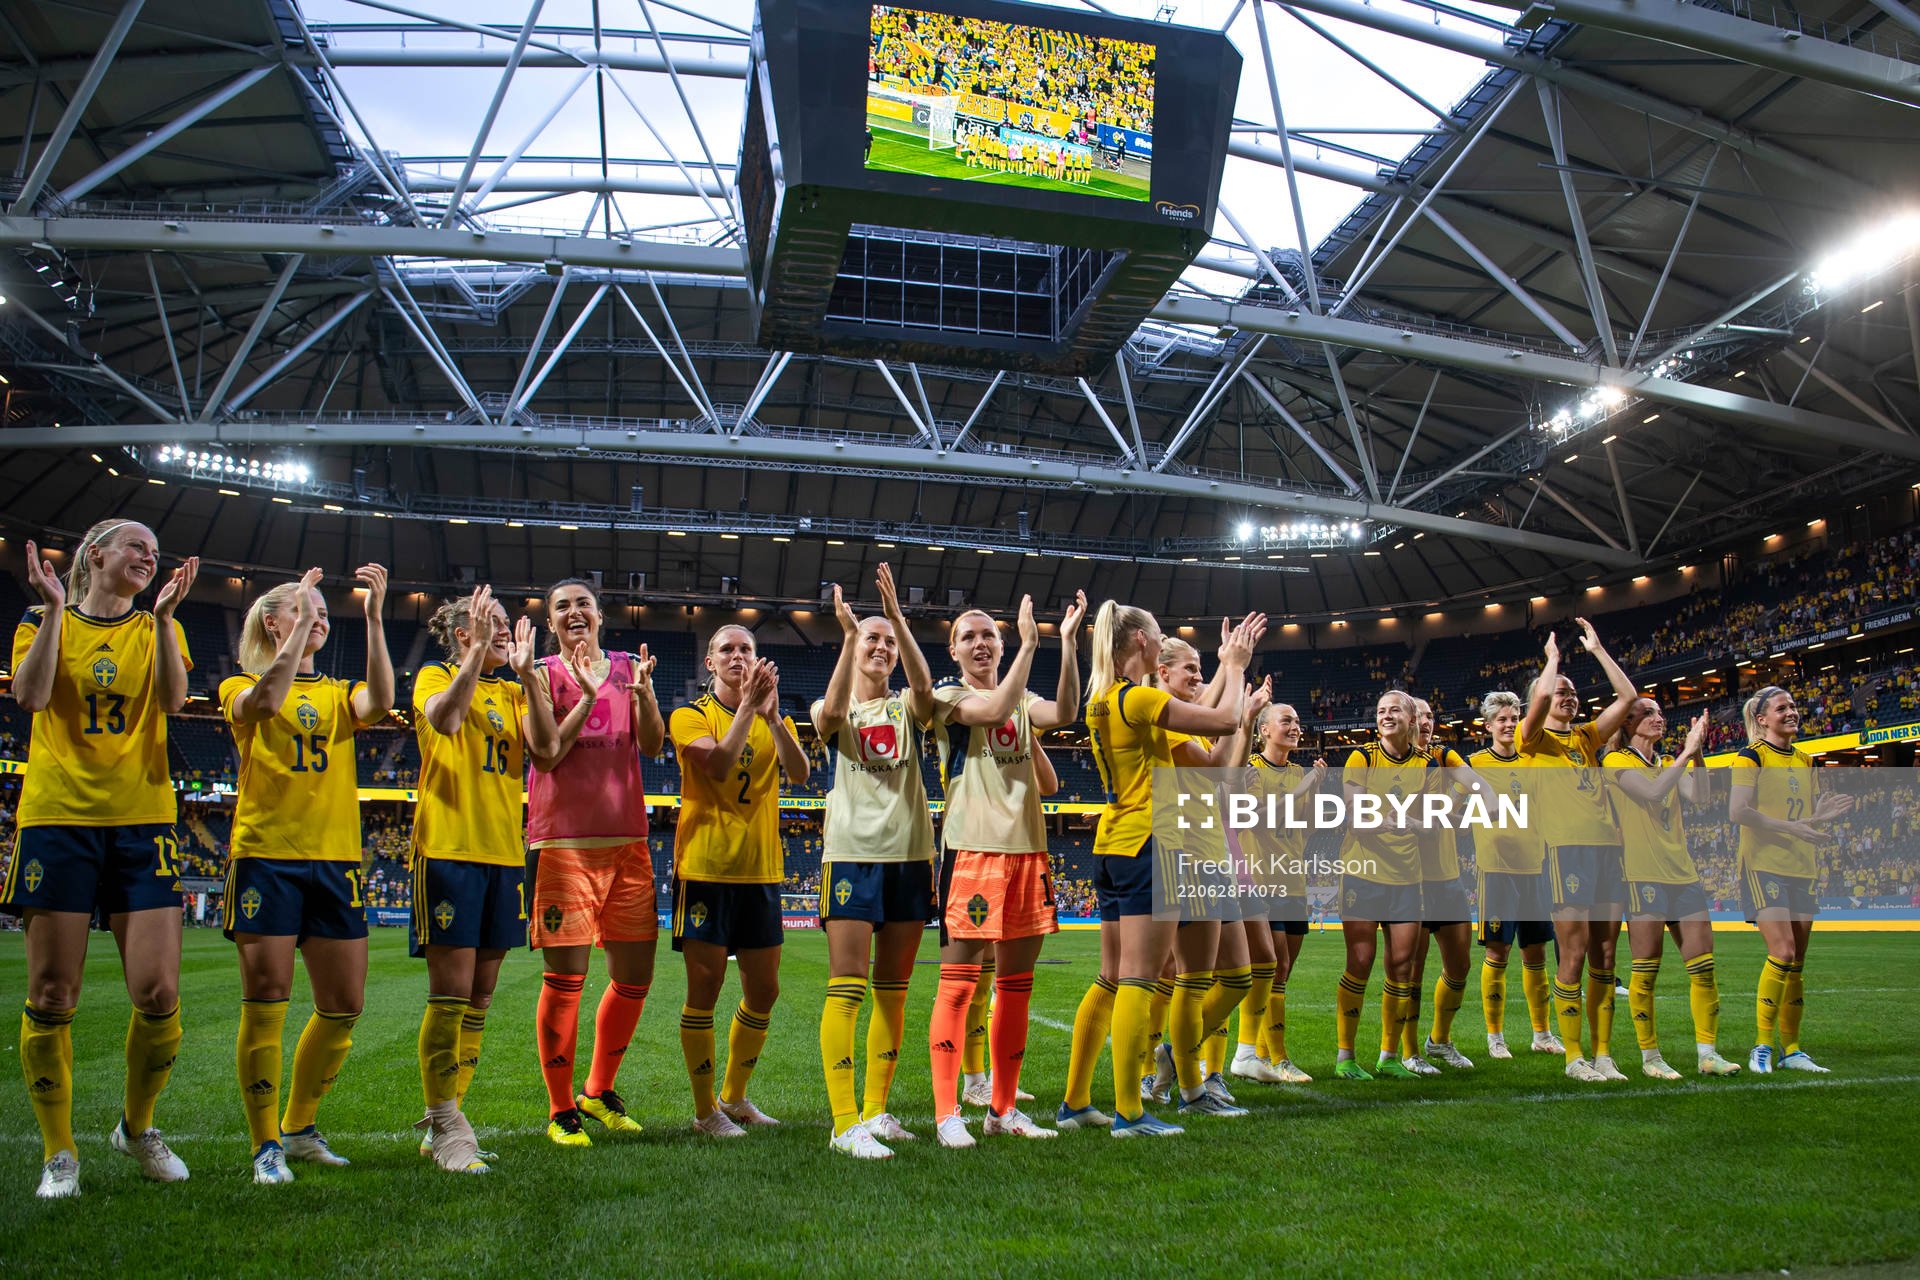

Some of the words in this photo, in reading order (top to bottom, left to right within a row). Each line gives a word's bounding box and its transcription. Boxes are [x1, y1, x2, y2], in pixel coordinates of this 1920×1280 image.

[1162, 205, 1193, 218] friends
[1865, 618, 1889, 630] FRIENDS
[1891, 611, 1911, 624] ARENA
[1772, 638, 1807, 652] TILLSAMMANS
[1808, 635, 1820, 645] MOT
[1820, 628, 1848, 641] MOBBNING
[84, 693, 126, 735] 13
[1891, 727, 1909, 740] NER
[290, 733, 328, 772] 15
[482, 735, 510, 775] 16
[213, 783, 232, 791] BRA
[737, 771, 750, 804] 2
[1786, 796, 1805, 822] 22
